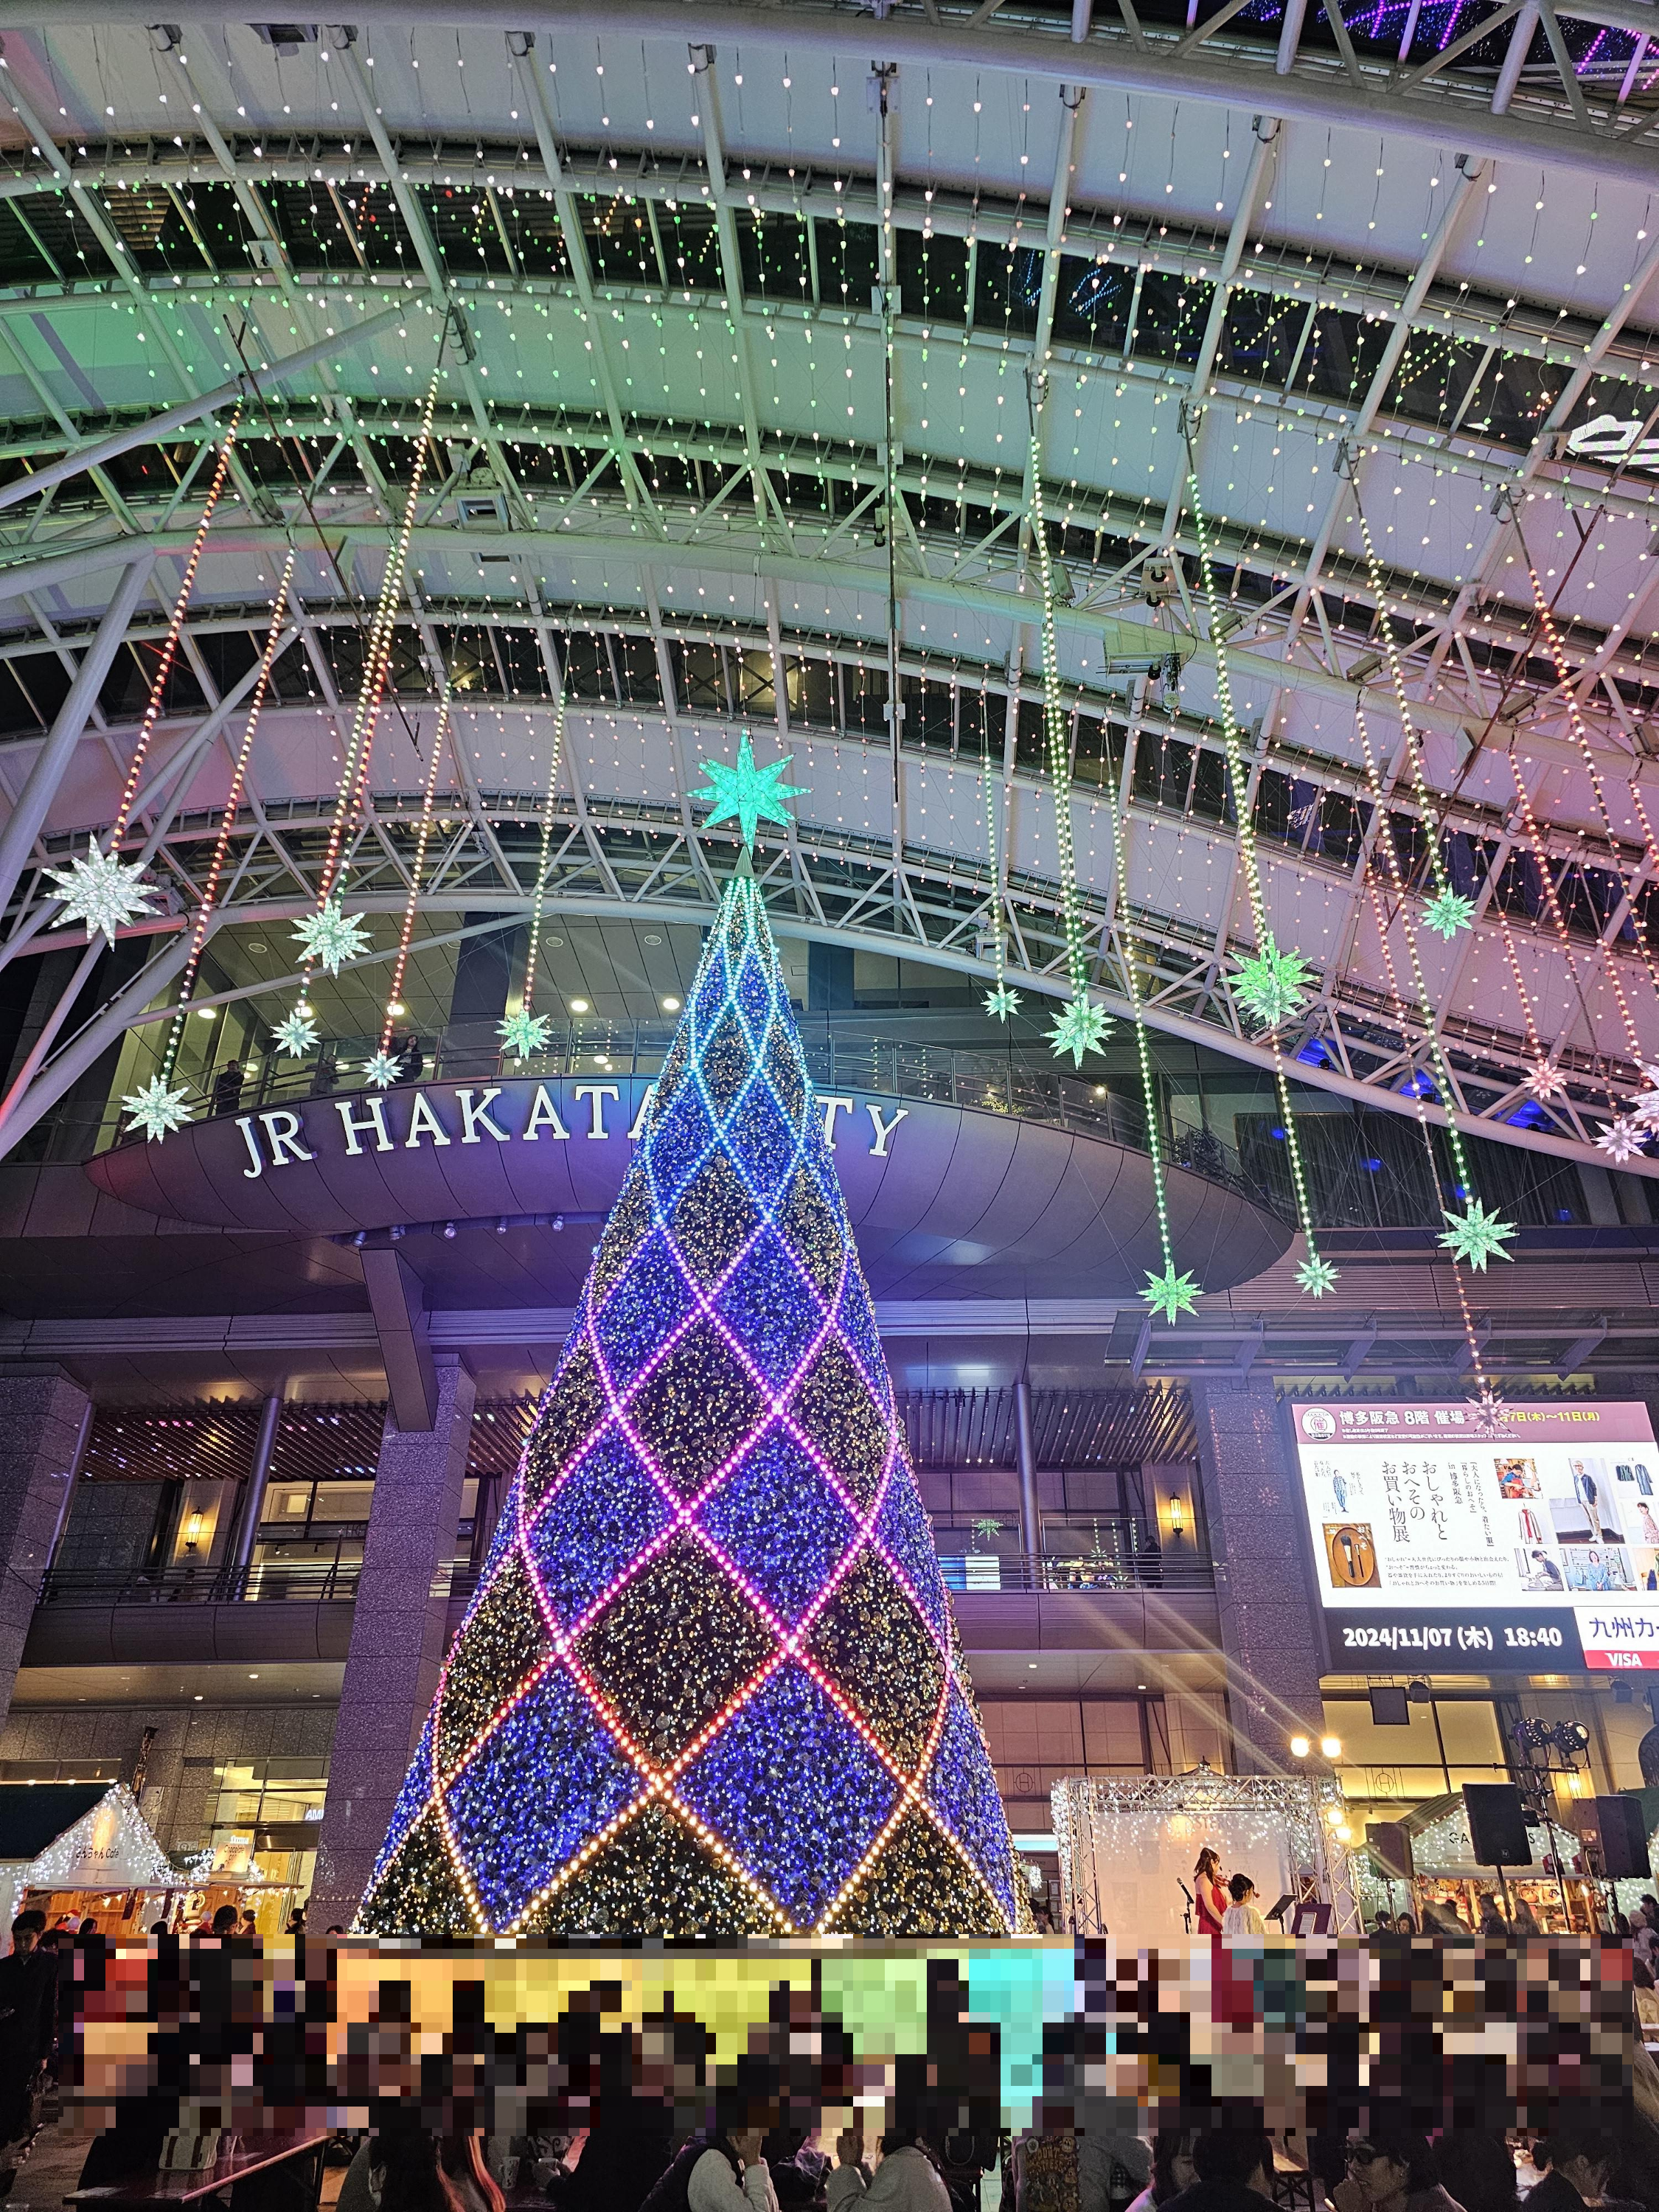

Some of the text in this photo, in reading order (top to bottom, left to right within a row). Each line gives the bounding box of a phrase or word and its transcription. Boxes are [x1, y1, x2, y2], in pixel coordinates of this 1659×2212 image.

[235, 1110, 317, 1178] JR
[815, 1096, 908, 1156] TY
[1339, 1410, 1465, 1425] 博多阪急 8階 催場
[1382, 1461, 1411, 1543] お買い物展
[1402, 1461, 1425, 1520] おへその
[1422, 1461, 1448, 1540] おしゃれと
[1450, 1472, 1463, 1504] 博多阪急
[1343, 1626, 1563, 1651] 2024/11/07 (木) 18:40
[1588, 1617, 1659, 1638] 九州カ
[1604, 1652, 1643, 1666] VISA
